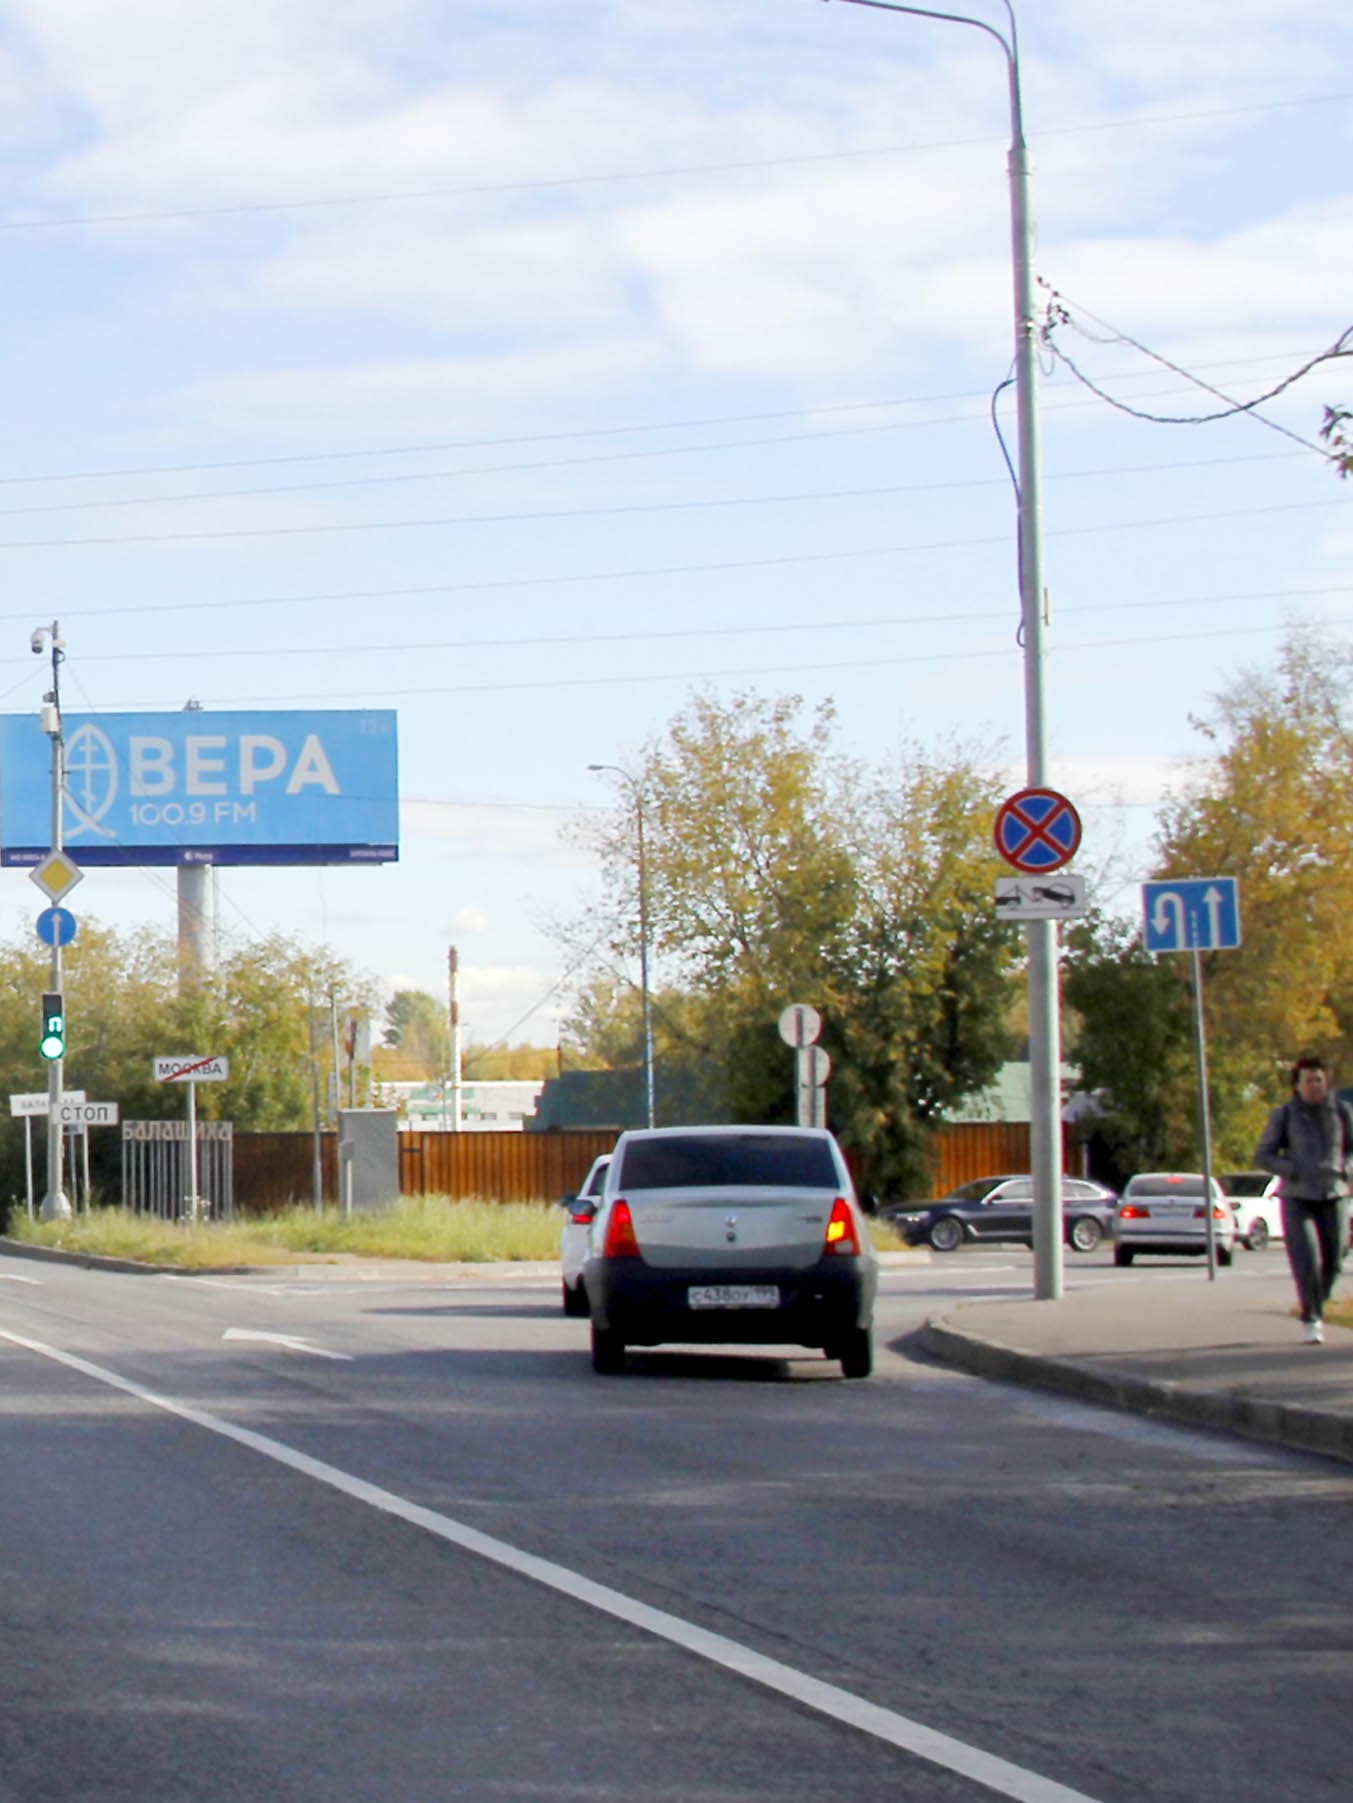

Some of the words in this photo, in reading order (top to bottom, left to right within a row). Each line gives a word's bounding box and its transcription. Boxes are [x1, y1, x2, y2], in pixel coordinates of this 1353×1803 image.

[128, 733, 341, 797] ВЕРА
[129, 802, 206, 826] 100.9
[214, 801, 257, 825] FM
[158, 1062, 223, 1075] МОСКВА
[60, 1106, 109, 1121] СТОП
